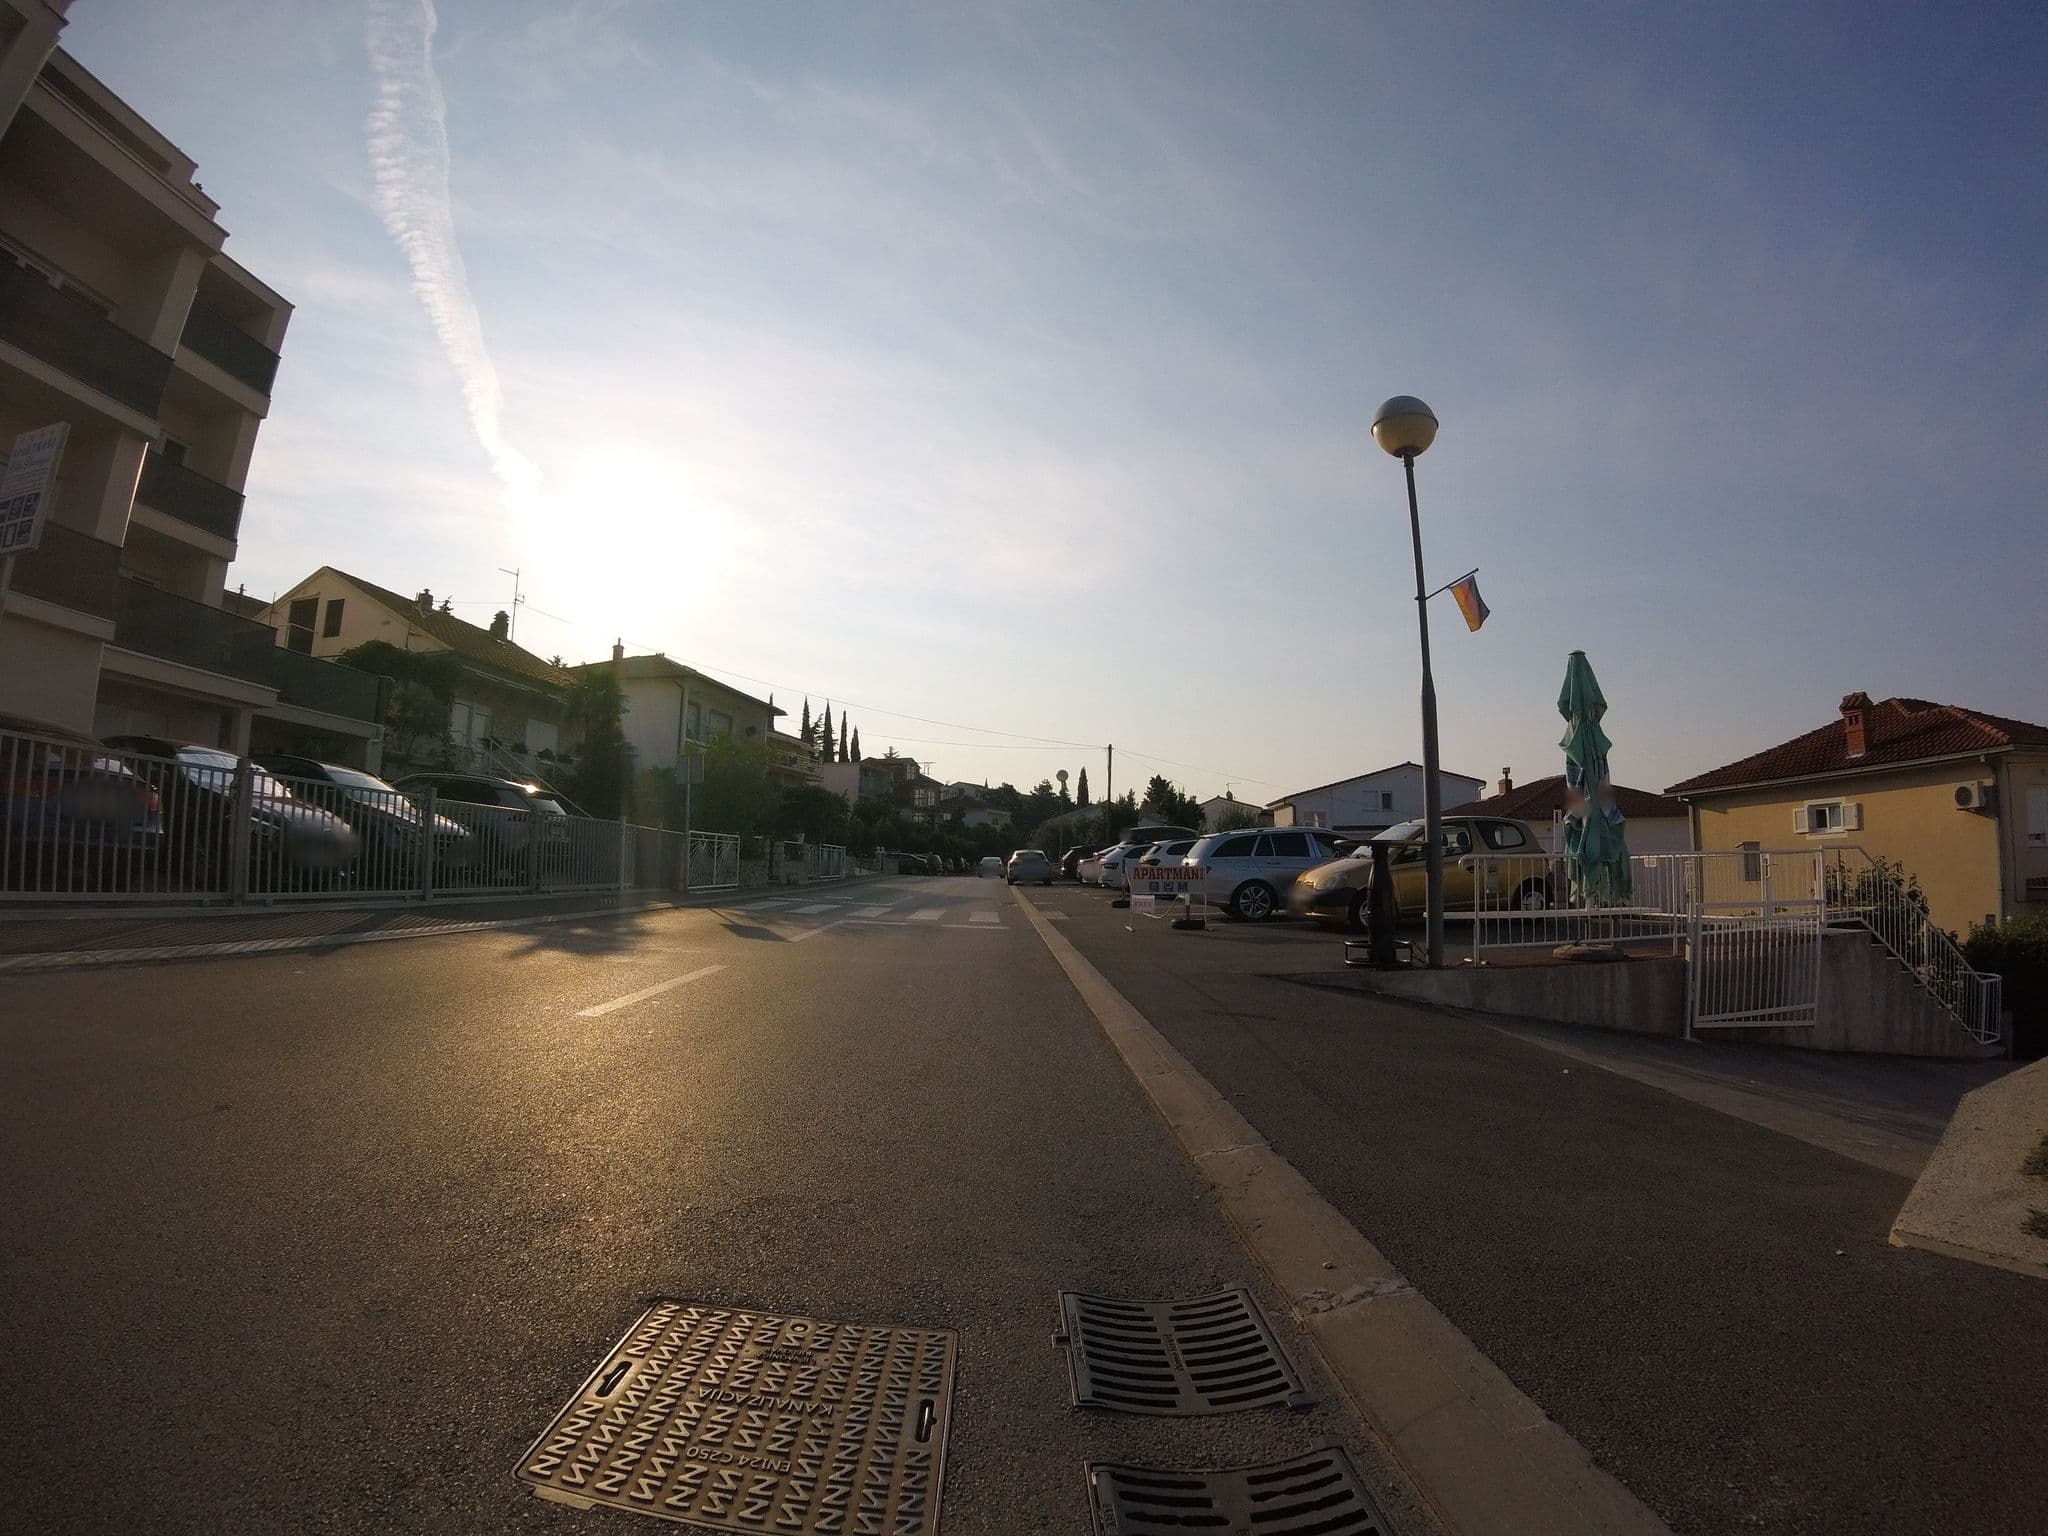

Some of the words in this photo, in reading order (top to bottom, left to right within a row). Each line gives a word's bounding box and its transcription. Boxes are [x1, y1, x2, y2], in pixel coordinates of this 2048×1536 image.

[1133, 867, 1204, 880] APARTMANI
[699, 1387, 833, 1415] KANALIZACIJA
[686, 1446, 733, 1464] C250
[737, 1454, 791, 1472] EN124
